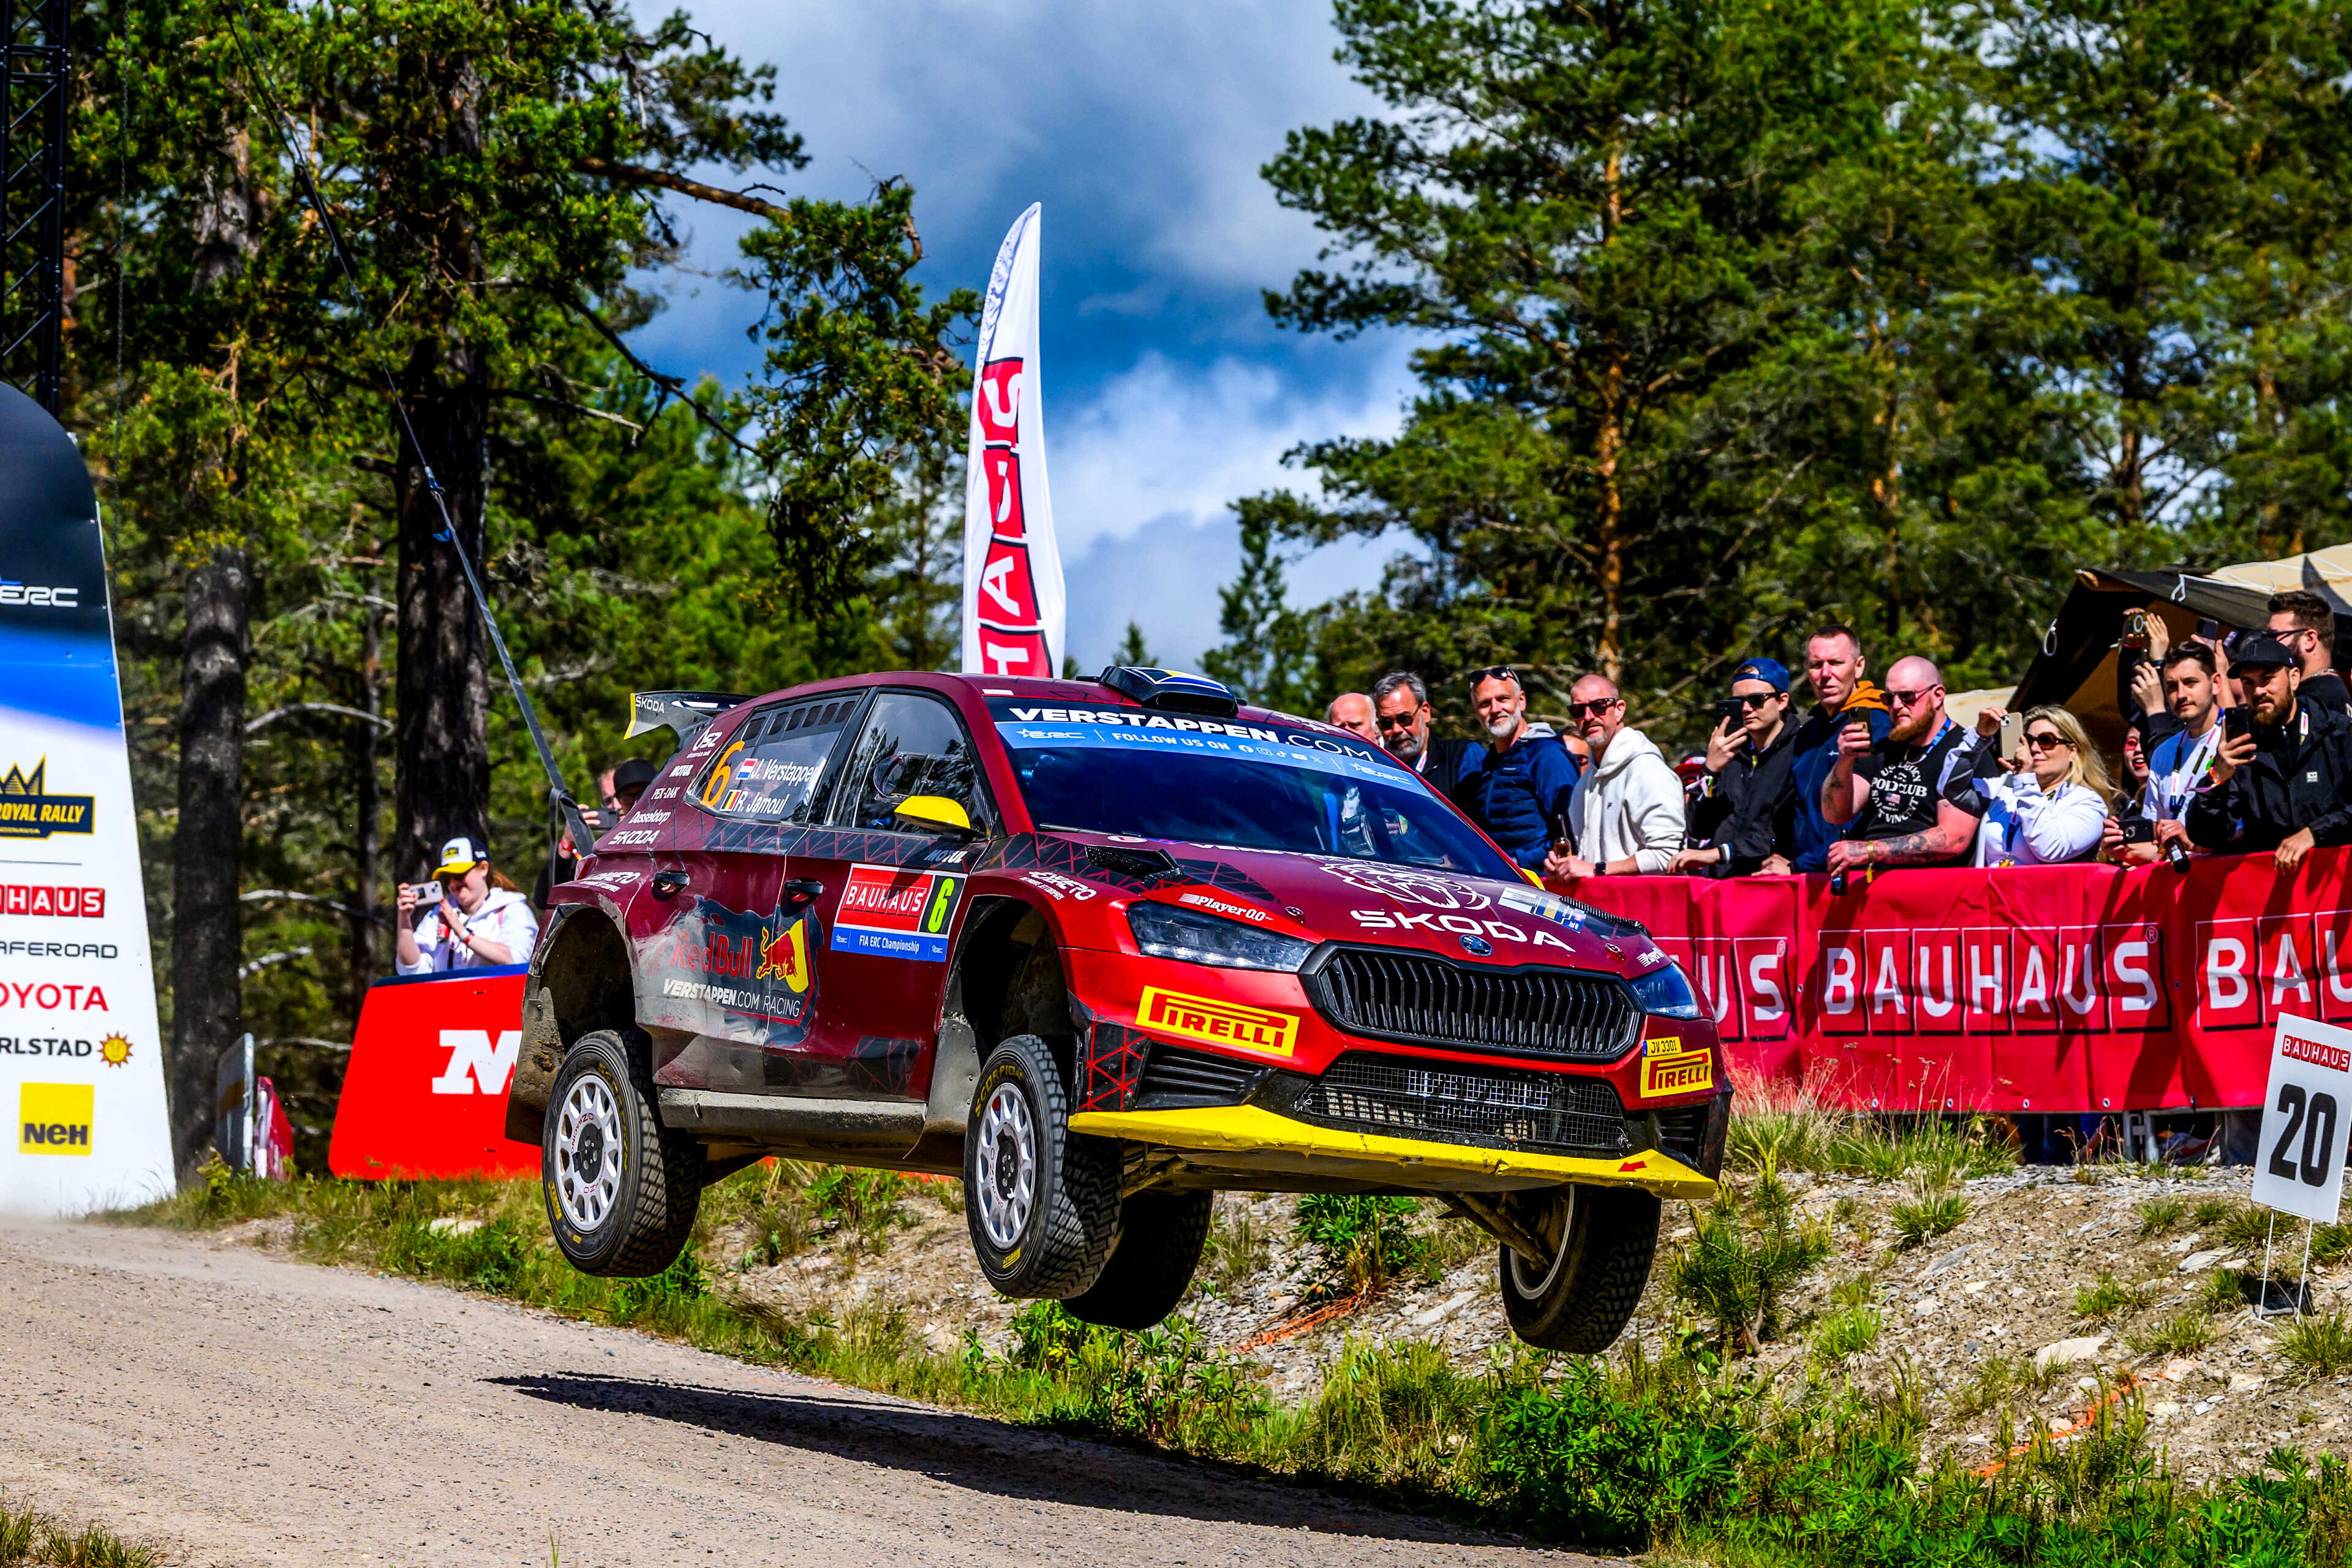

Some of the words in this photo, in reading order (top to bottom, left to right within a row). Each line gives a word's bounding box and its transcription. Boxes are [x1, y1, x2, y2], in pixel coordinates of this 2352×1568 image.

[0, 585, 78, 608] ERC
[1112, 733, 1177, 745] FOLLOW
[1180, 738, 1204, 748] US
[1207, 741, 1231, 750] ON
[669, 764, 694, 777] MOTUL
[699, 740, 745, 808] 6
[750, 758, 760, 780] J.
[0, 802, 37, 821] OYAL
[39, 804, 86, 823] RALLY
[733, 791, 744, 812] R.
[746, 791, 790, 815] Jamoul
[628, 809, 671, 825] Dusseldorp
[924, 849, 968, 864] MOTUL
[0, 888, 101, 913] HAUS
[846, 885, 924, 912] BAUHAUS
[928, 878, 955, 933] 6
[859, 935, 869, 946] FIA
[870, 937, 880, 948] ERC
[881, 937, 919, 954] Championship
[1669, 954, 1785, 1024] US
[1823, 941, 2158, 1017] BAUHAUS
[763, 995, 801, 1017] RACING
[1148, 992, 1288, 1048] PIRELLI
[1651, 1041, 1660, 1053] JV
[1662, 1039, 1677, 1052] 3301
[2283, 1036, 2350, 1068] BAUHAUS
[1648, 1052, 1708, 1090] PIRELLI
[2268, 1083, 2337, 1188] 20
